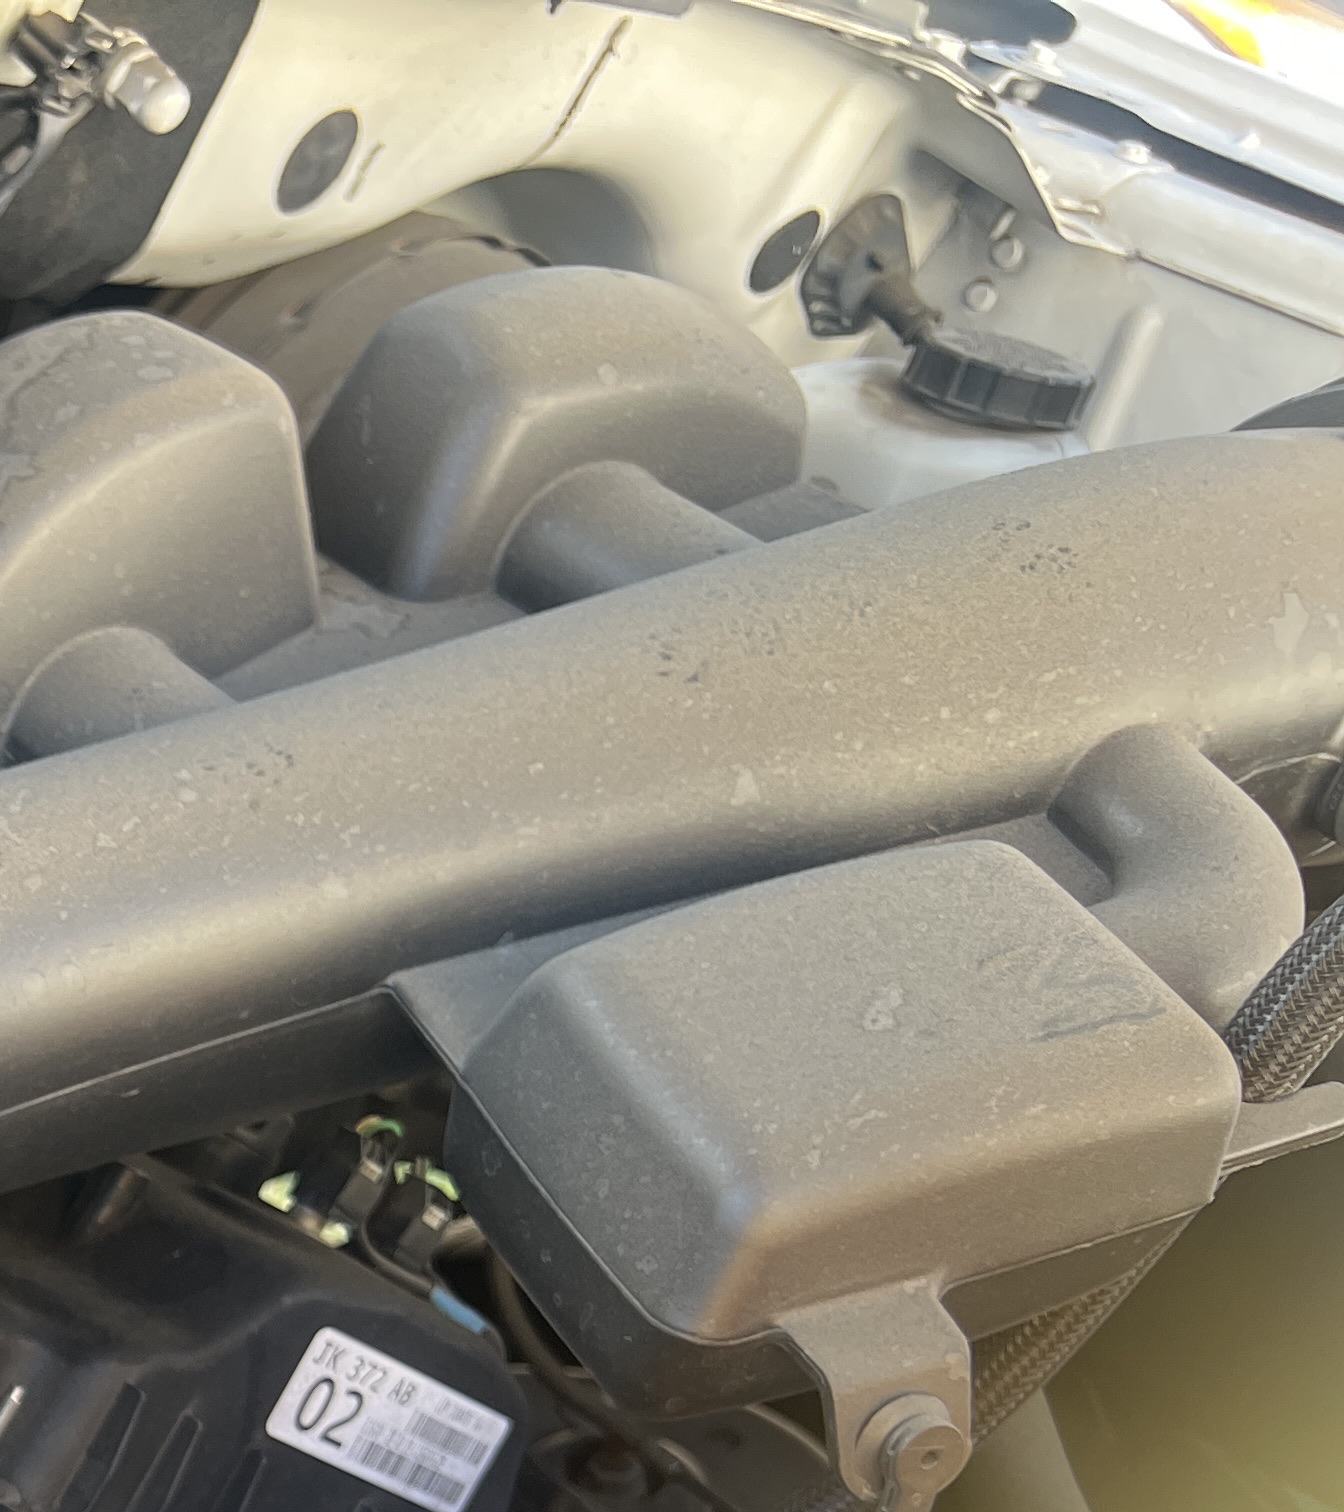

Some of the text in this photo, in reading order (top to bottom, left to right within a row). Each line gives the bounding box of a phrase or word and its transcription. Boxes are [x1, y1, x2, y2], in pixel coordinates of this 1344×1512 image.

[350, 1357, 387, 1394] 372
[389, 1379, 417, 1406] AB
[296, 1377, 363, 1448] 02
